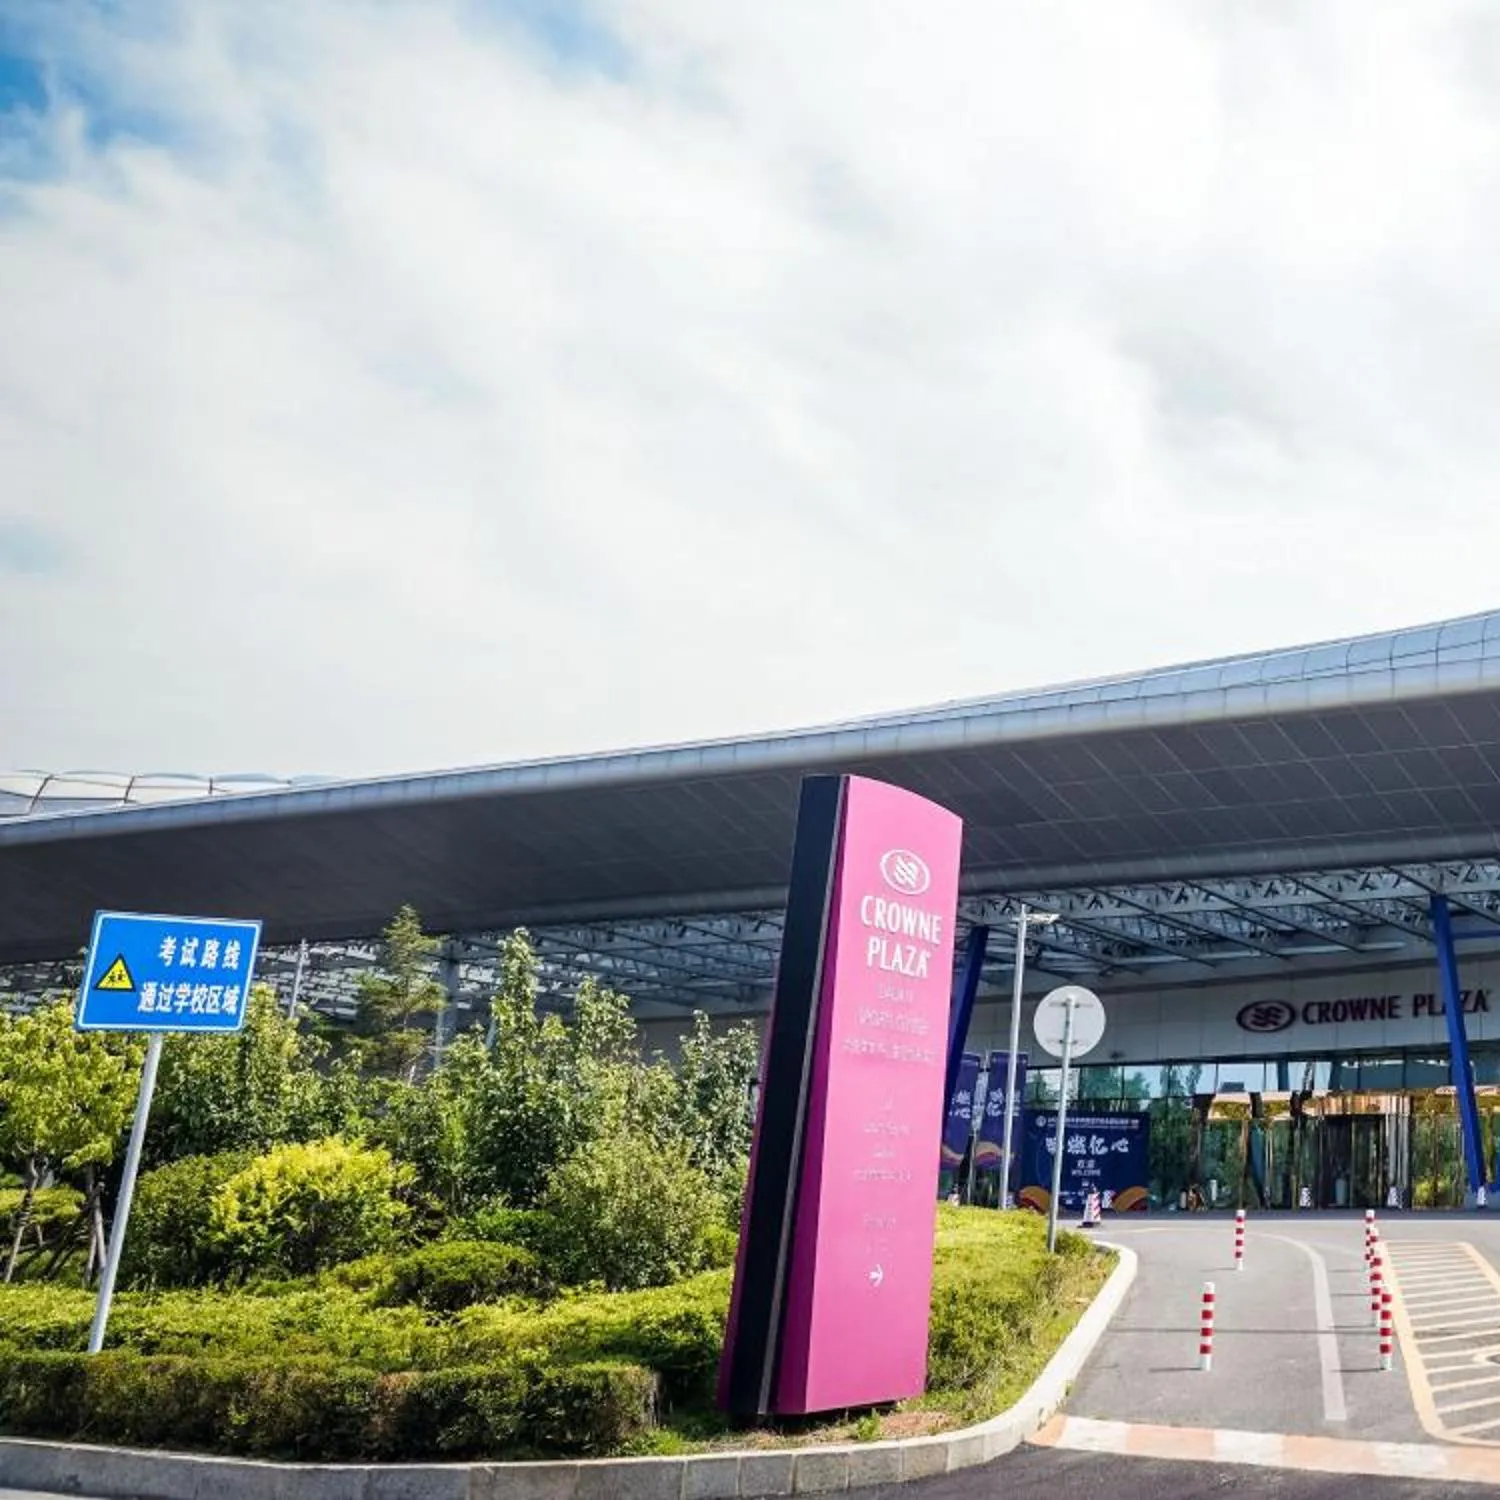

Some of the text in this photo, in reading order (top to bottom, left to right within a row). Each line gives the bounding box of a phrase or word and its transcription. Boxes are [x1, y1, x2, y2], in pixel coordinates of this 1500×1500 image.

[861, 895, 942, 944] CROWNE
[158, 936, 241, 970] 考试路线
[867, 936, 931, 978] PLAZA
[137, 981, 241, 1015] 通过学校区域
[1302, 989, 1492, 1025] CROWNE PLZA
